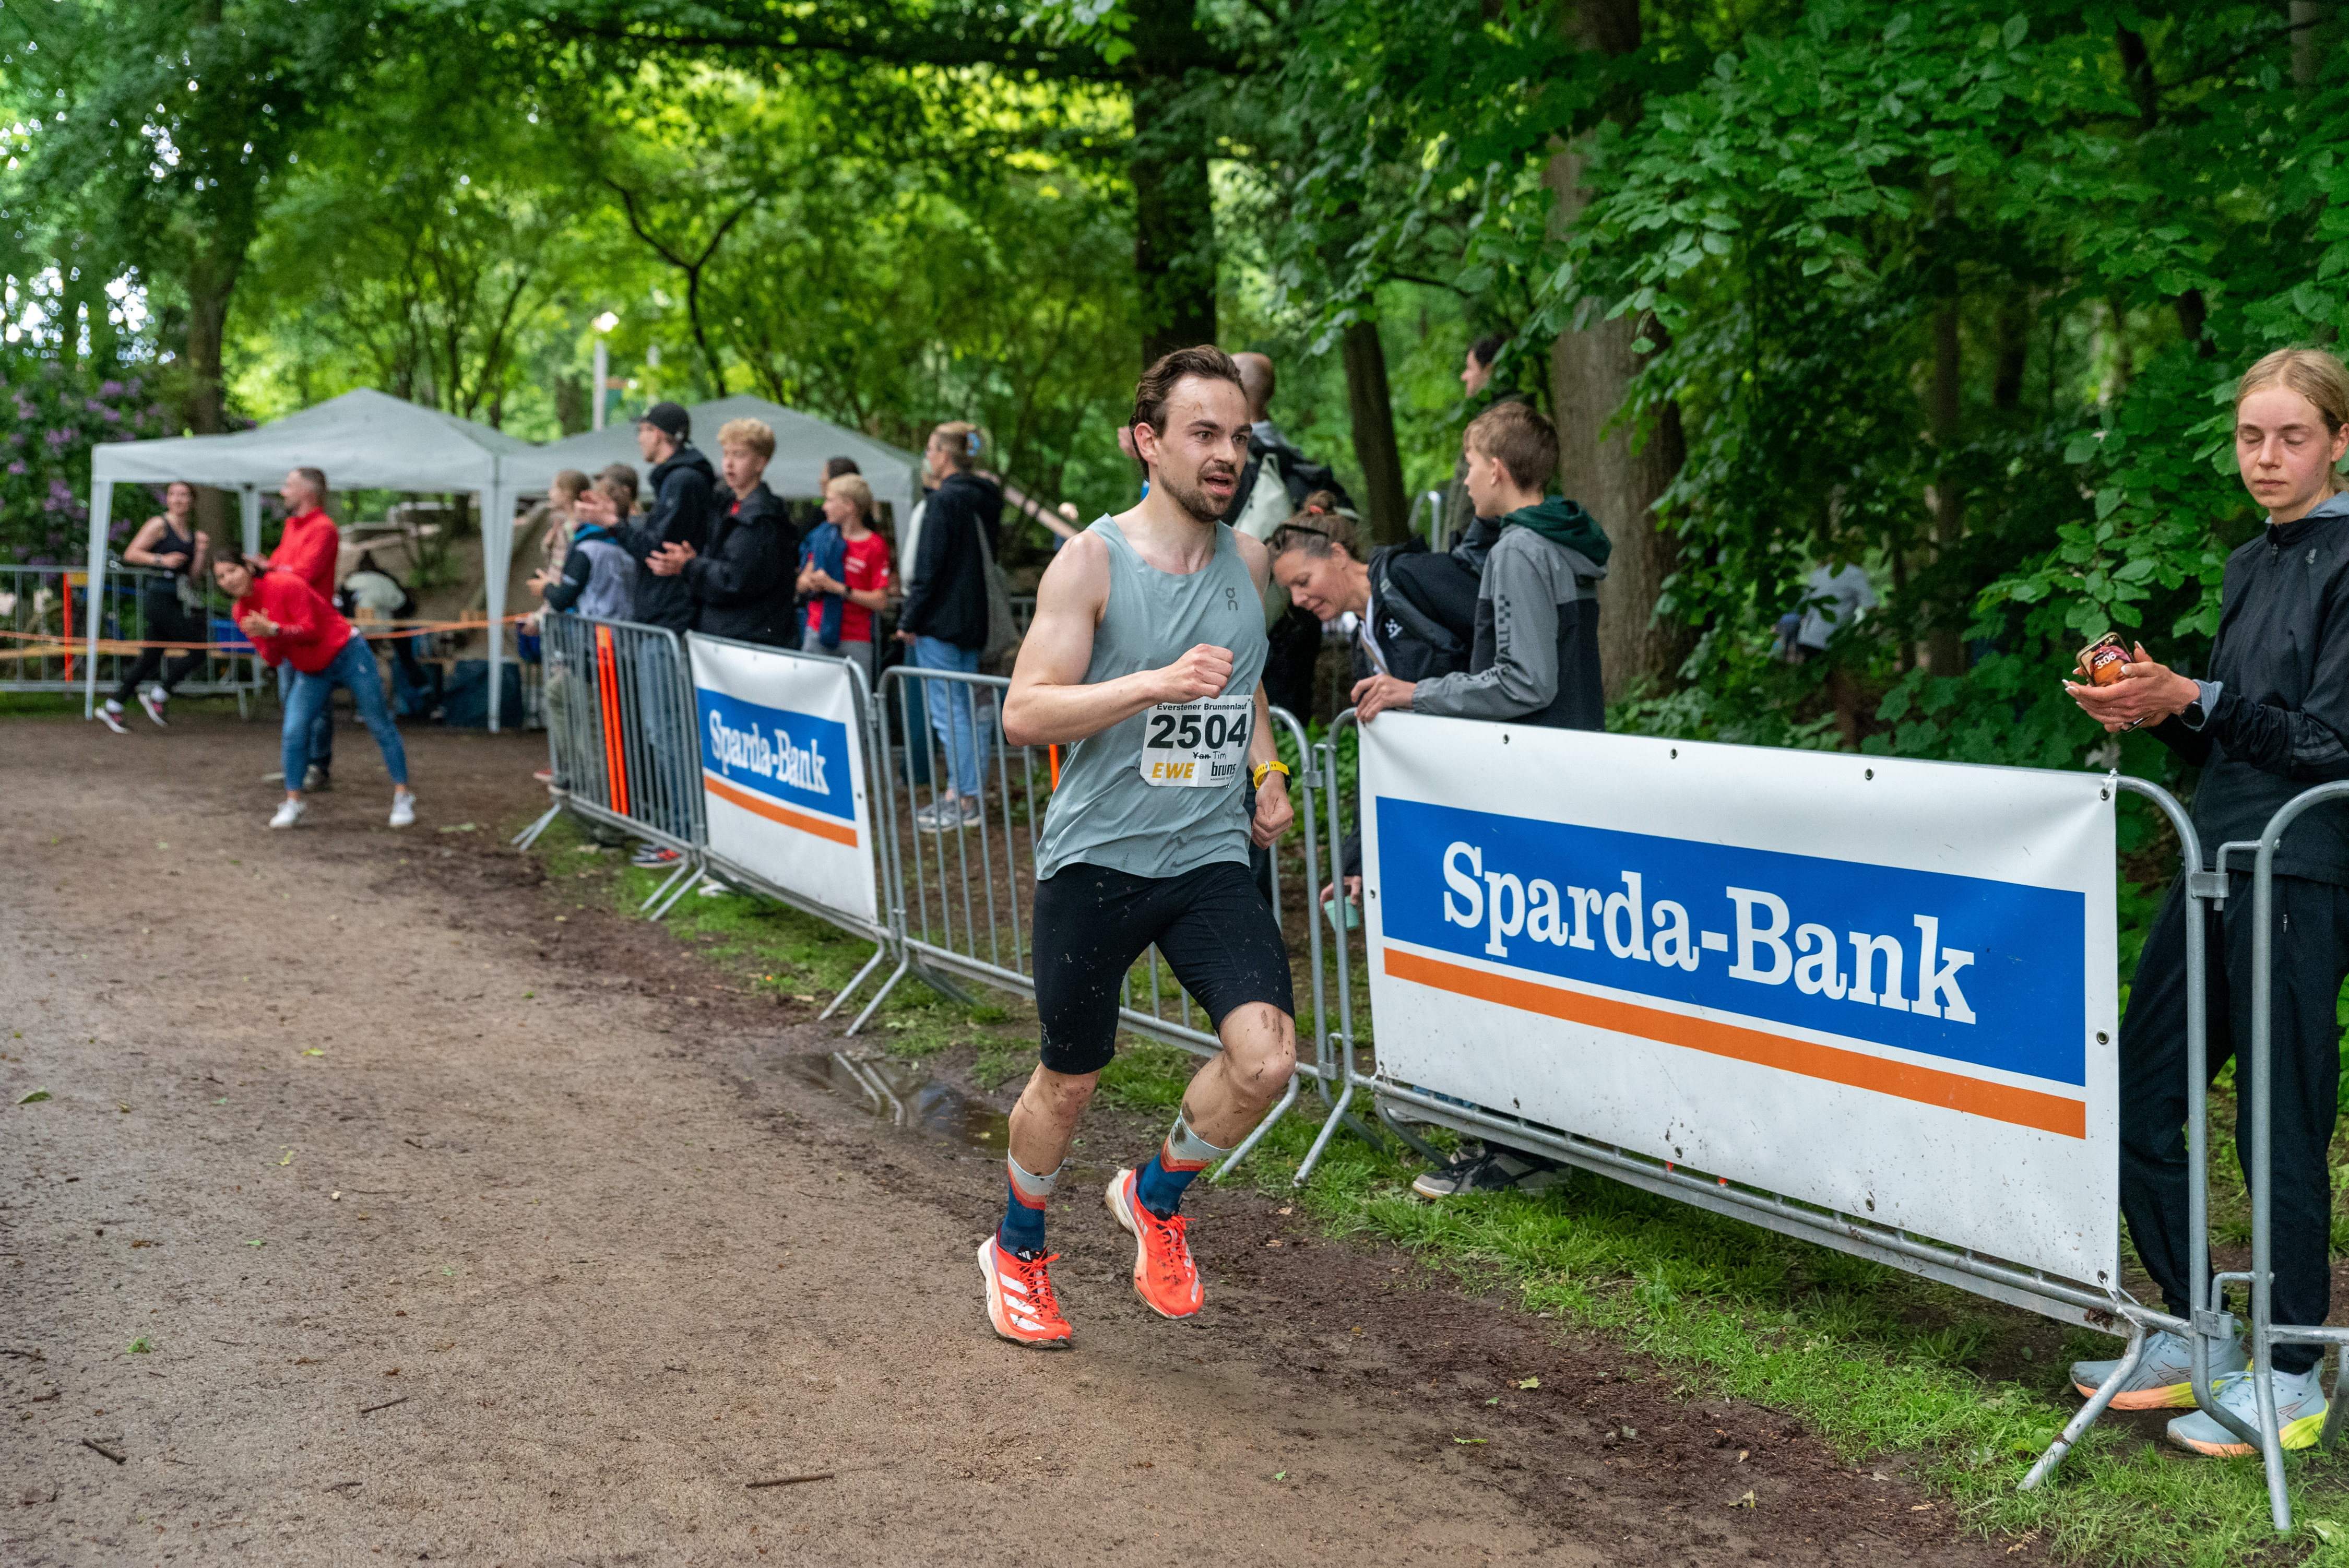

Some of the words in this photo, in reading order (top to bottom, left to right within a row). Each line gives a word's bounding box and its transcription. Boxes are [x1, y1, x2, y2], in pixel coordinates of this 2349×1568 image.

[2095, 651, 2117, 669] 3:06
[1147, 714, 1247, 749] 2504
[709, 709, 830, 795] Sparda-Bank
[1213, 751, 1226, 759] Tim
[1152, 763, 1195, 779] EWE
[1211, 762, 1237, 776] bruns
[1442, 841, 1977, 1025] Sparda-Bank
